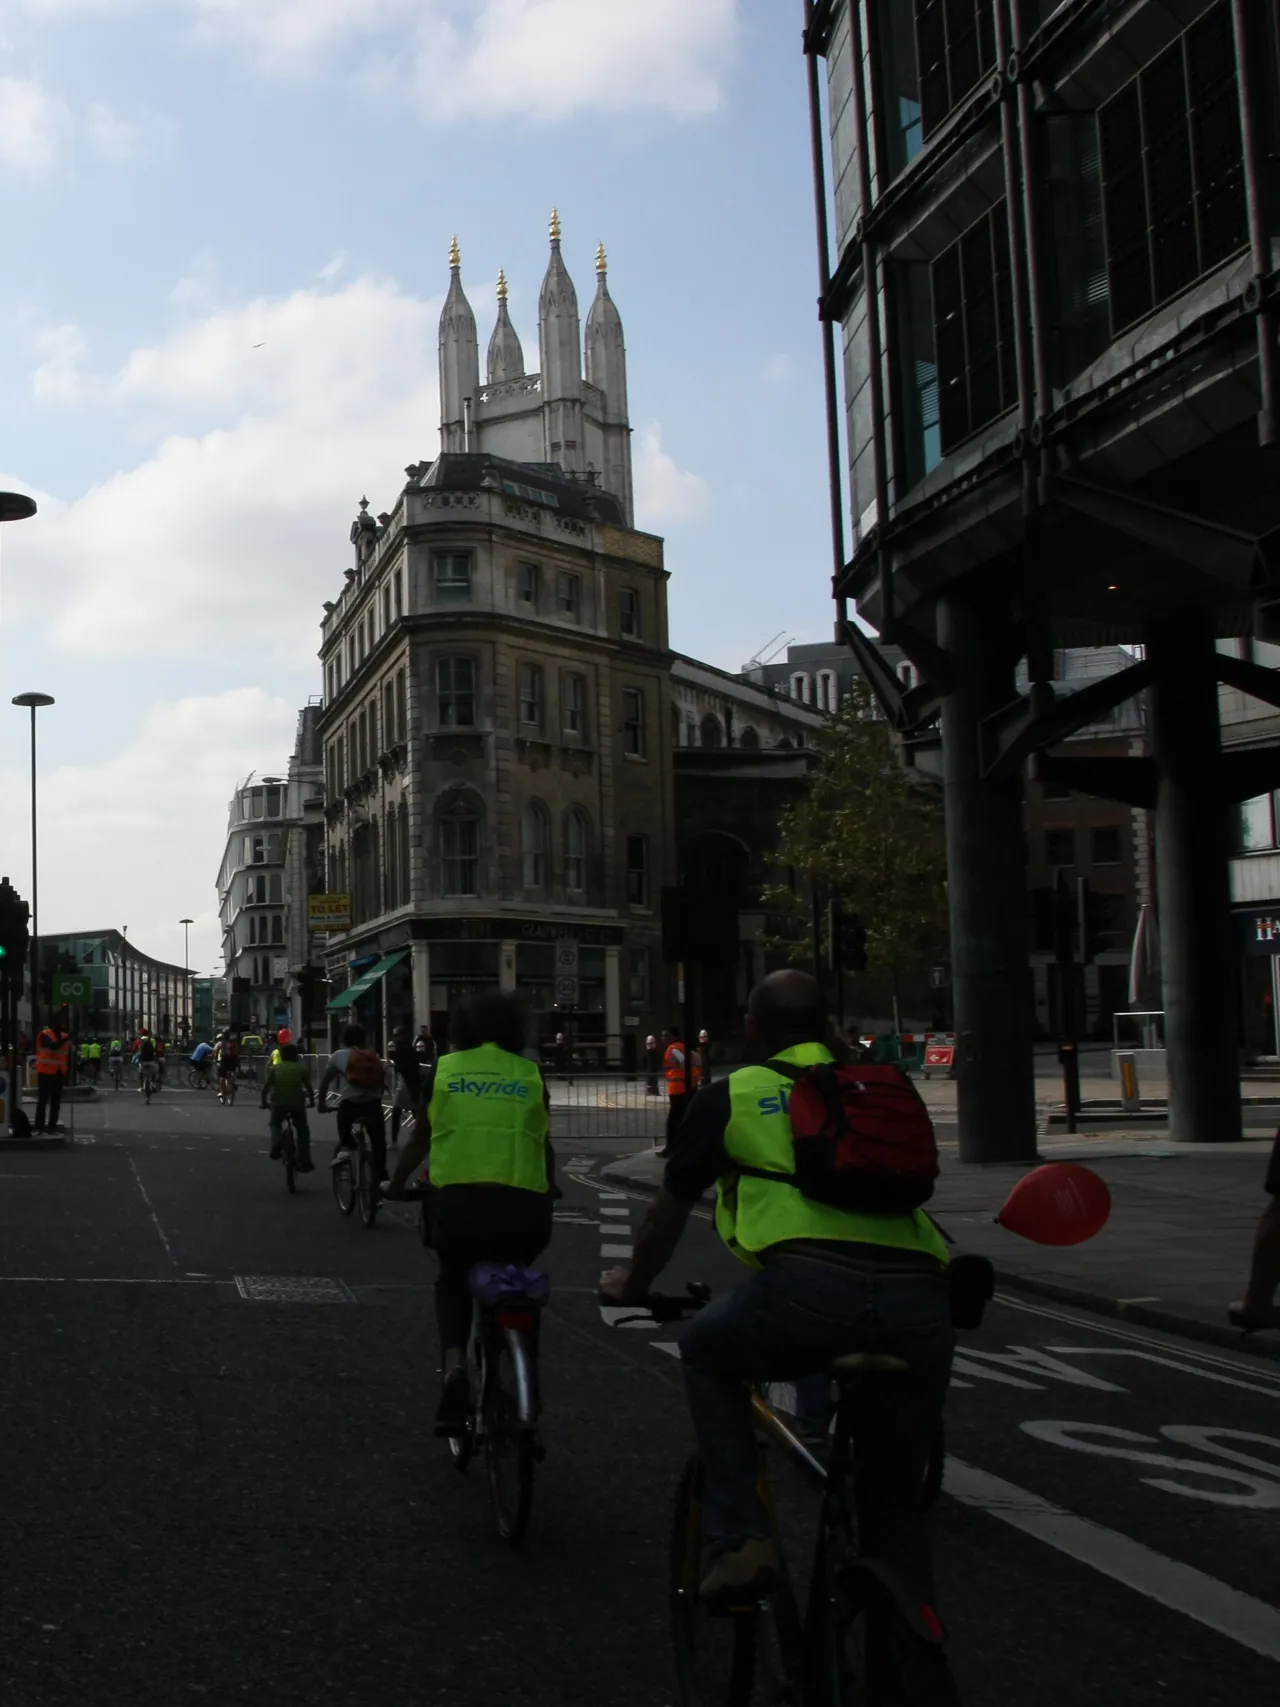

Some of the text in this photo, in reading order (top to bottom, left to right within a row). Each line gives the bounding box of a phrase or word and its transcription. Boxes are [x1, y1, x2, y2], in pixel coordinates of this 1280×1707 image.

[311, 904, 349, 914] TO LET
[60, 982, 84, 996] GO
[447, 1078, 529, 1098] skyride
